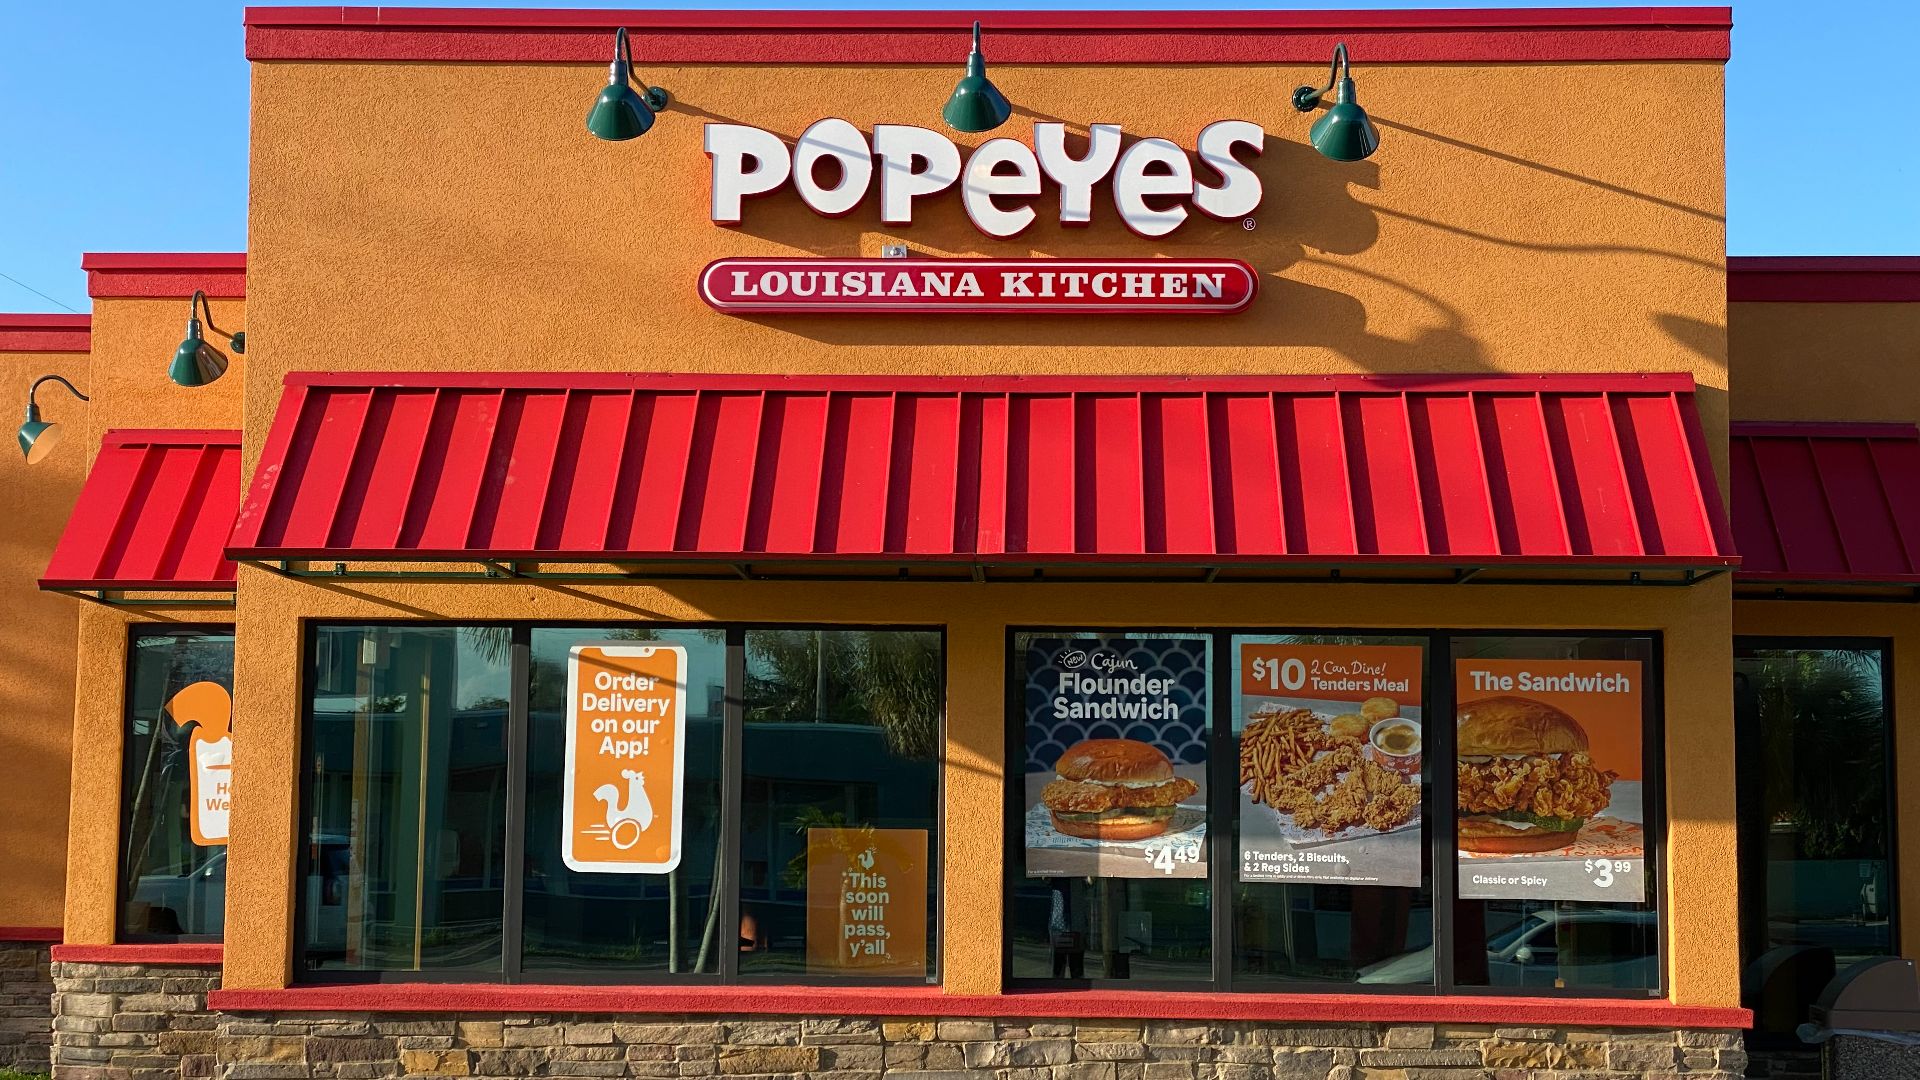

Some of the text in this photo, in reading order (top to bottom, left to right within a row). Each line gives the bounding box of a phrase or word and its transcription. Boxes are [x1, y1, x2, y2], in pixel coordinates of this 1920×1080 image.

[730, 271, 1226, 298] LOUISIANA KITCHEN
[1090, 652, 1138, 674] Cajun
[1310, 659, 1387, 676] 2 Can Dine!
[594, 671, 660, 691] Order
[1252, 656, 1306, 691] $10
[1469, 671, 1630, 693] The Sandwich
[1059, 672, 1175, 696] Flounder
[1310, 676, 1409, 692] Tenders Meal
[582, 692, 670, 717] Delivery
[1052, 696, 1179, 720] Sandwich
[590, 718, 660, 734] on our
[598, 735, 649, 759] App!
[1244, 850, 1350, 864] 6 Tenders, 2 Biscuits,
[1244, 862, 1310, 874] & 2 Reg Sides
[849, 872, 887, 889] This
[1472, 874, 1548, 887] Classic or Spicy
[845, 891, 890, 904] soon
[851, 905, 884, 920] will
[844, 923, 891, 939] pass,
